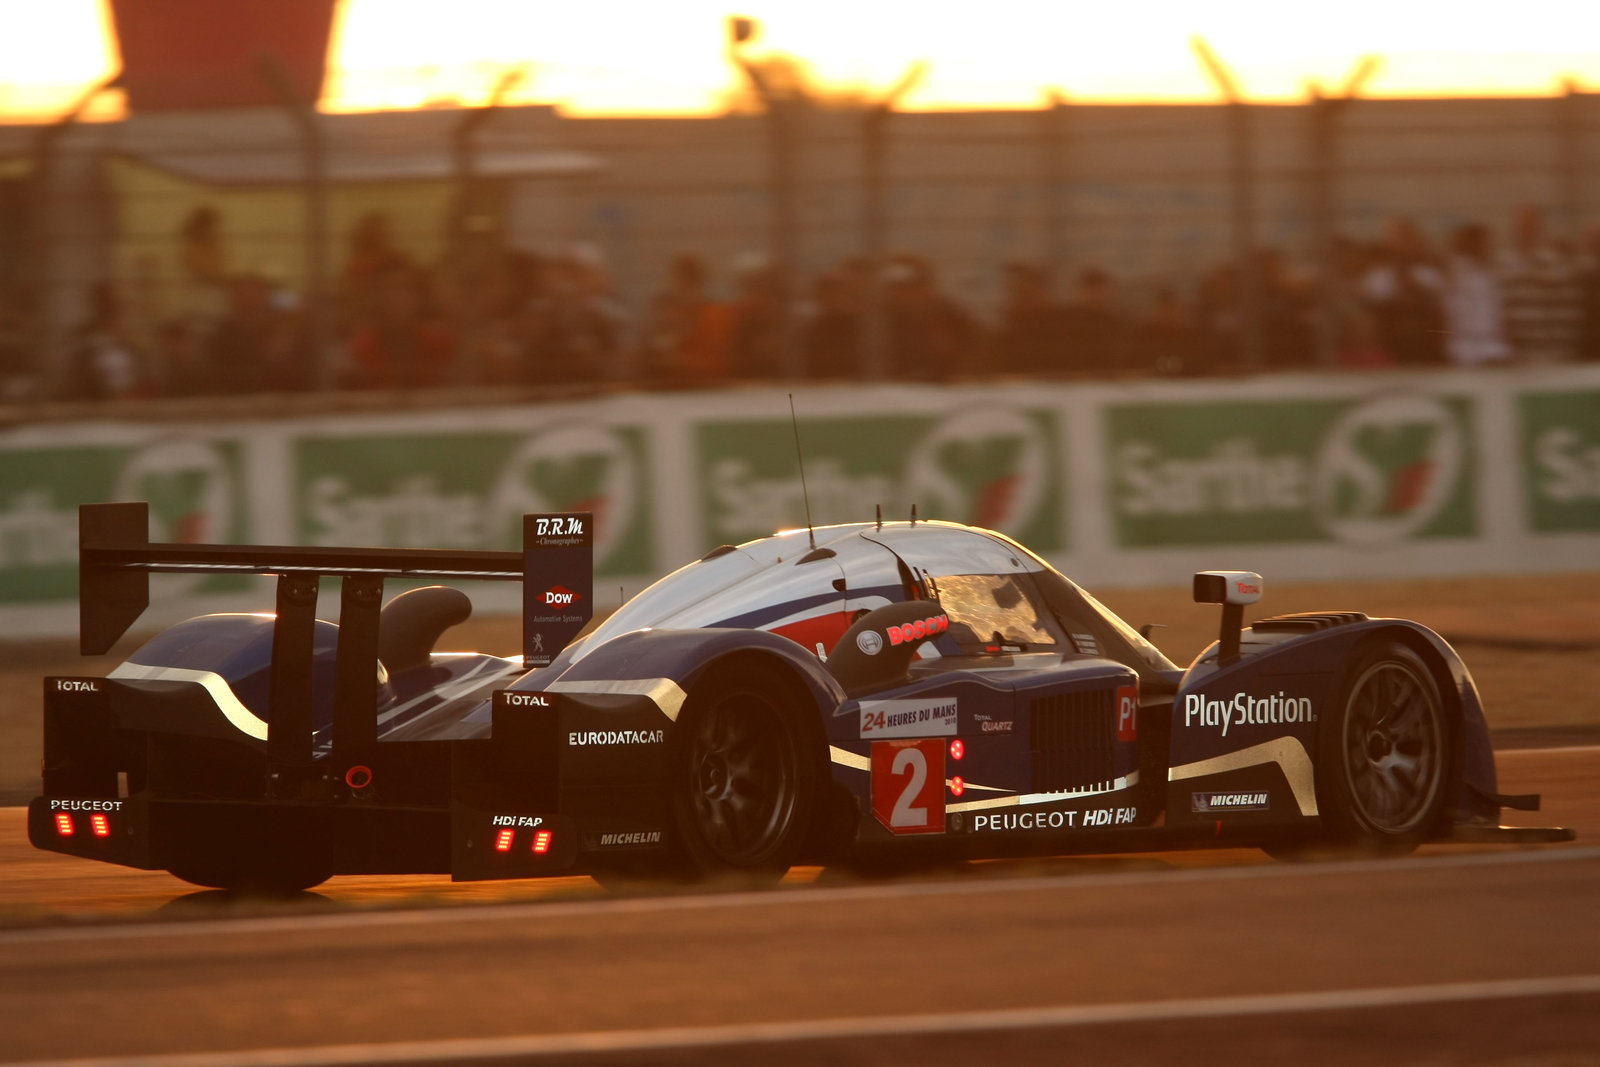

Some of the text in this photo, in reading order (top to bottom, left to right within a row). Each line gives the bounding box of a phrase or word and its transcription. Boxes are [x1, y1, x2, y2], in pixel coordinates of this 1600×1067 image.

[533, 614, 583, 624] Automotive Systems
[887, 614, 949, 646] BOSCH
[503, 692, 550, 707] TOTAL
[862, 703, 957, 732] 24 HEURES DU MANS
[1119, 696, 1137, 732] P1
[981, 721, 1014, 732] QUARTZ
[568, 730, 665, 746] EURODATACAR
[890, 747, 929, 828] 2
[50, 800, 123, 811] PEUGEOT
[1209, 793, 1268, 807] MICHELIN
[492, 815, 543, 828] HDi FAP
[974, 807, 1137, 832] PEUGEOT HDi FAP
[600, 831, 662, 846] MICHELIN
